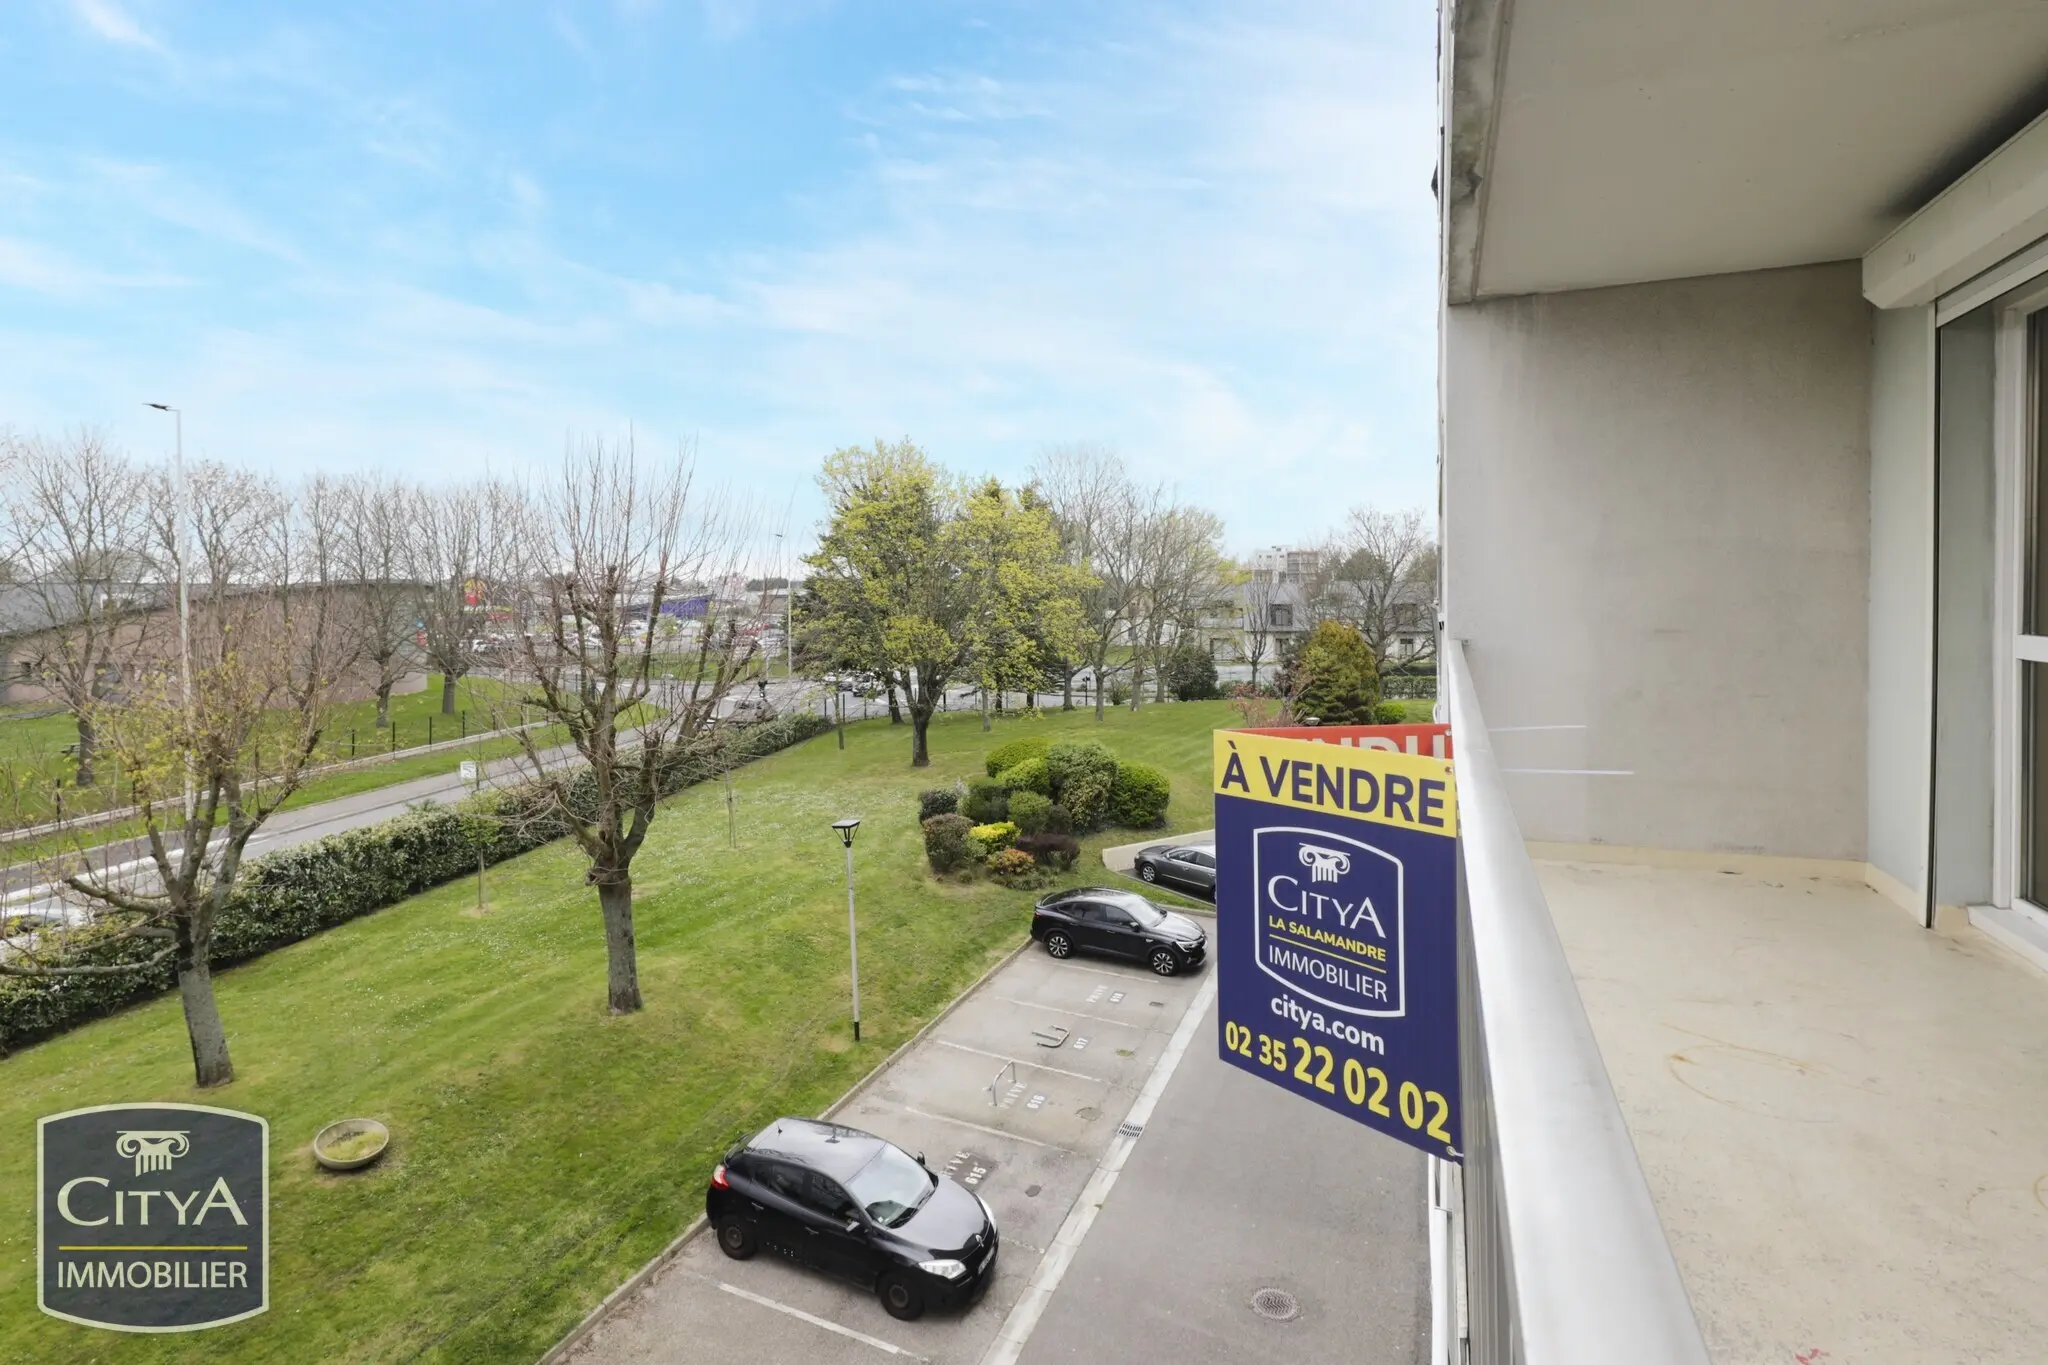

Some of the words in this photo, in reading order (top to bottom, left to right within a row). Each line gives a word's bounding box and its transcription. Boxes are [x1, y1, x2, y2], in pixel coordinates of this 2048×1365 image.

[1221, 740, 1250, 793] À
[1259, 755, 1446, 828] VENDRE
[1268, 875, 1387, 939] CITYA
[1269, 915, 1285, 931] LA
[1289, 921, 1386, 962] SALAMANDRE
[1269, 945, 1388, 1003] IMMOBILIER
[1271, 994, 1385, 1056] citya.com
[1225, 1021, 1252, 1059] 02
[1258, 1034, 1287, 1072] 35
[1293, 1037, 1335, 1095] 22
[1343, 1058, 1390, 1118] 02
[1399, 1081, 1451, 1144] 02
[964, 1166, 987, 1185] 615
